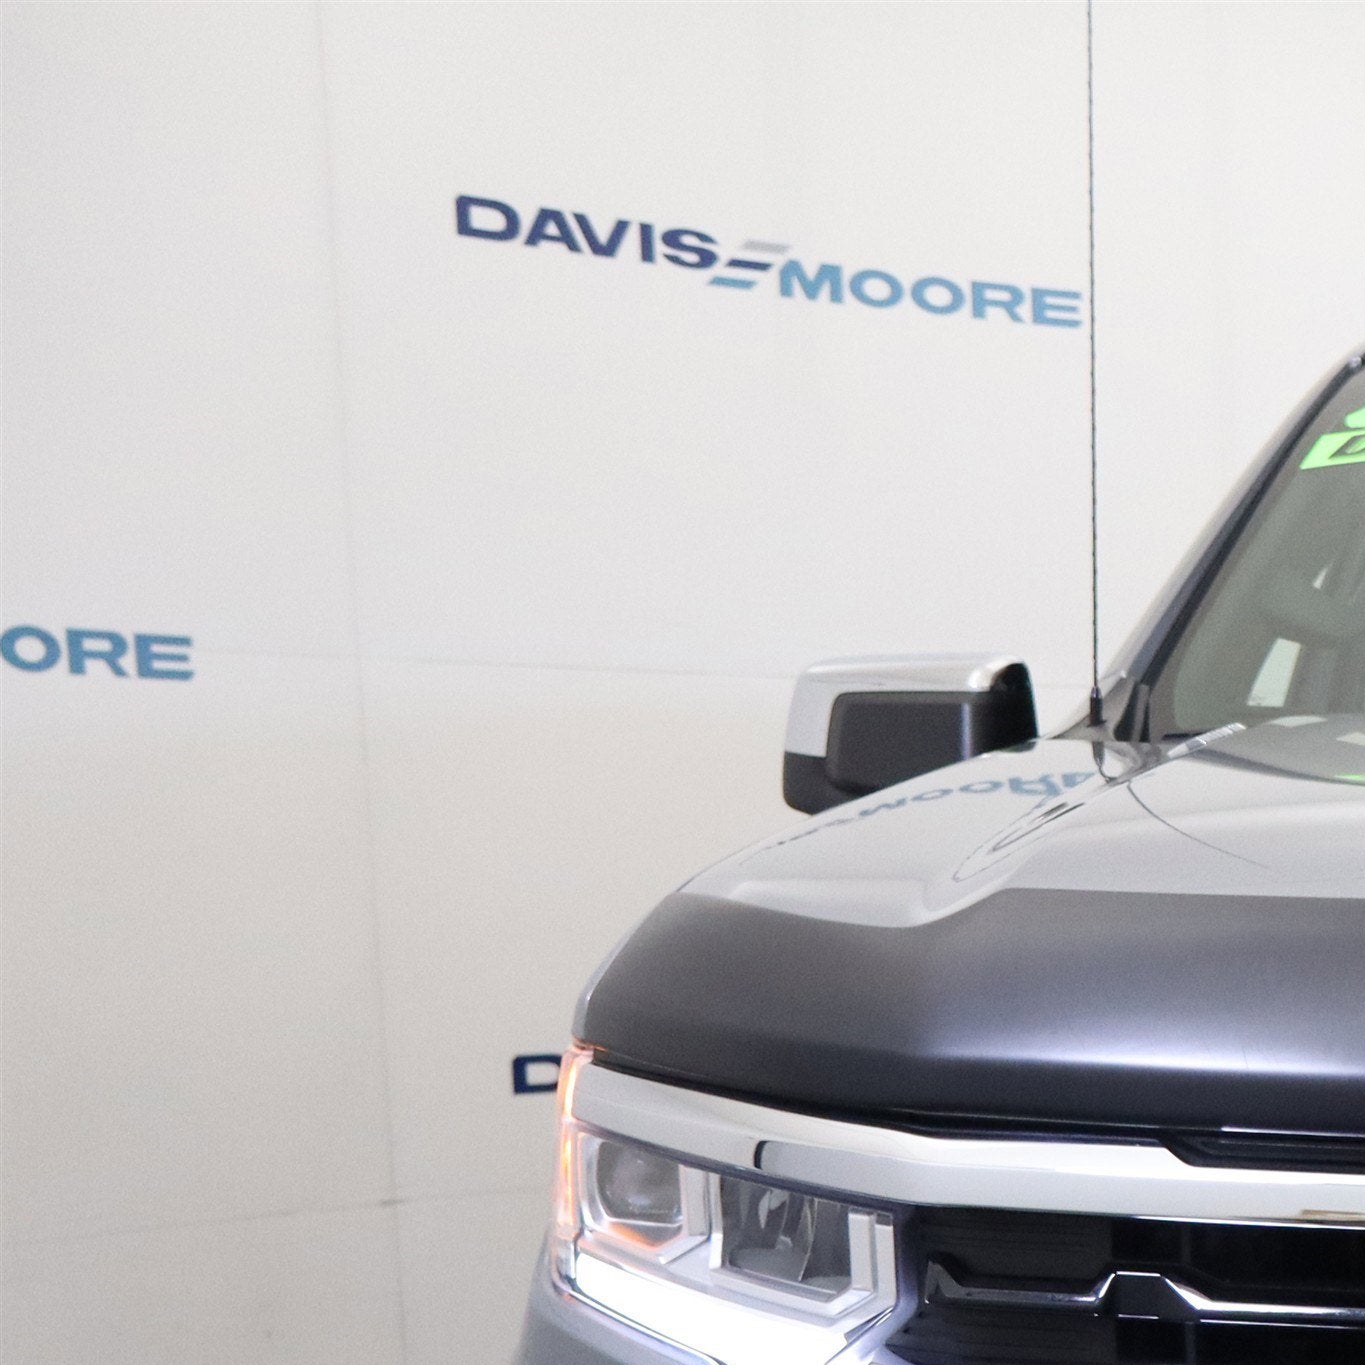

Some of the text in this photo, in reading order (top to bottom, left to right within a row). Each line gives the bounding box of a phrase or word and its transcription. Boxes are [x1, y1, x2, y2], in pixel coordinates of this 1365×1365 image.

[455, 195, 1083, 328] DAVIS MOORE
[0, 624, 194, 680] ORE
